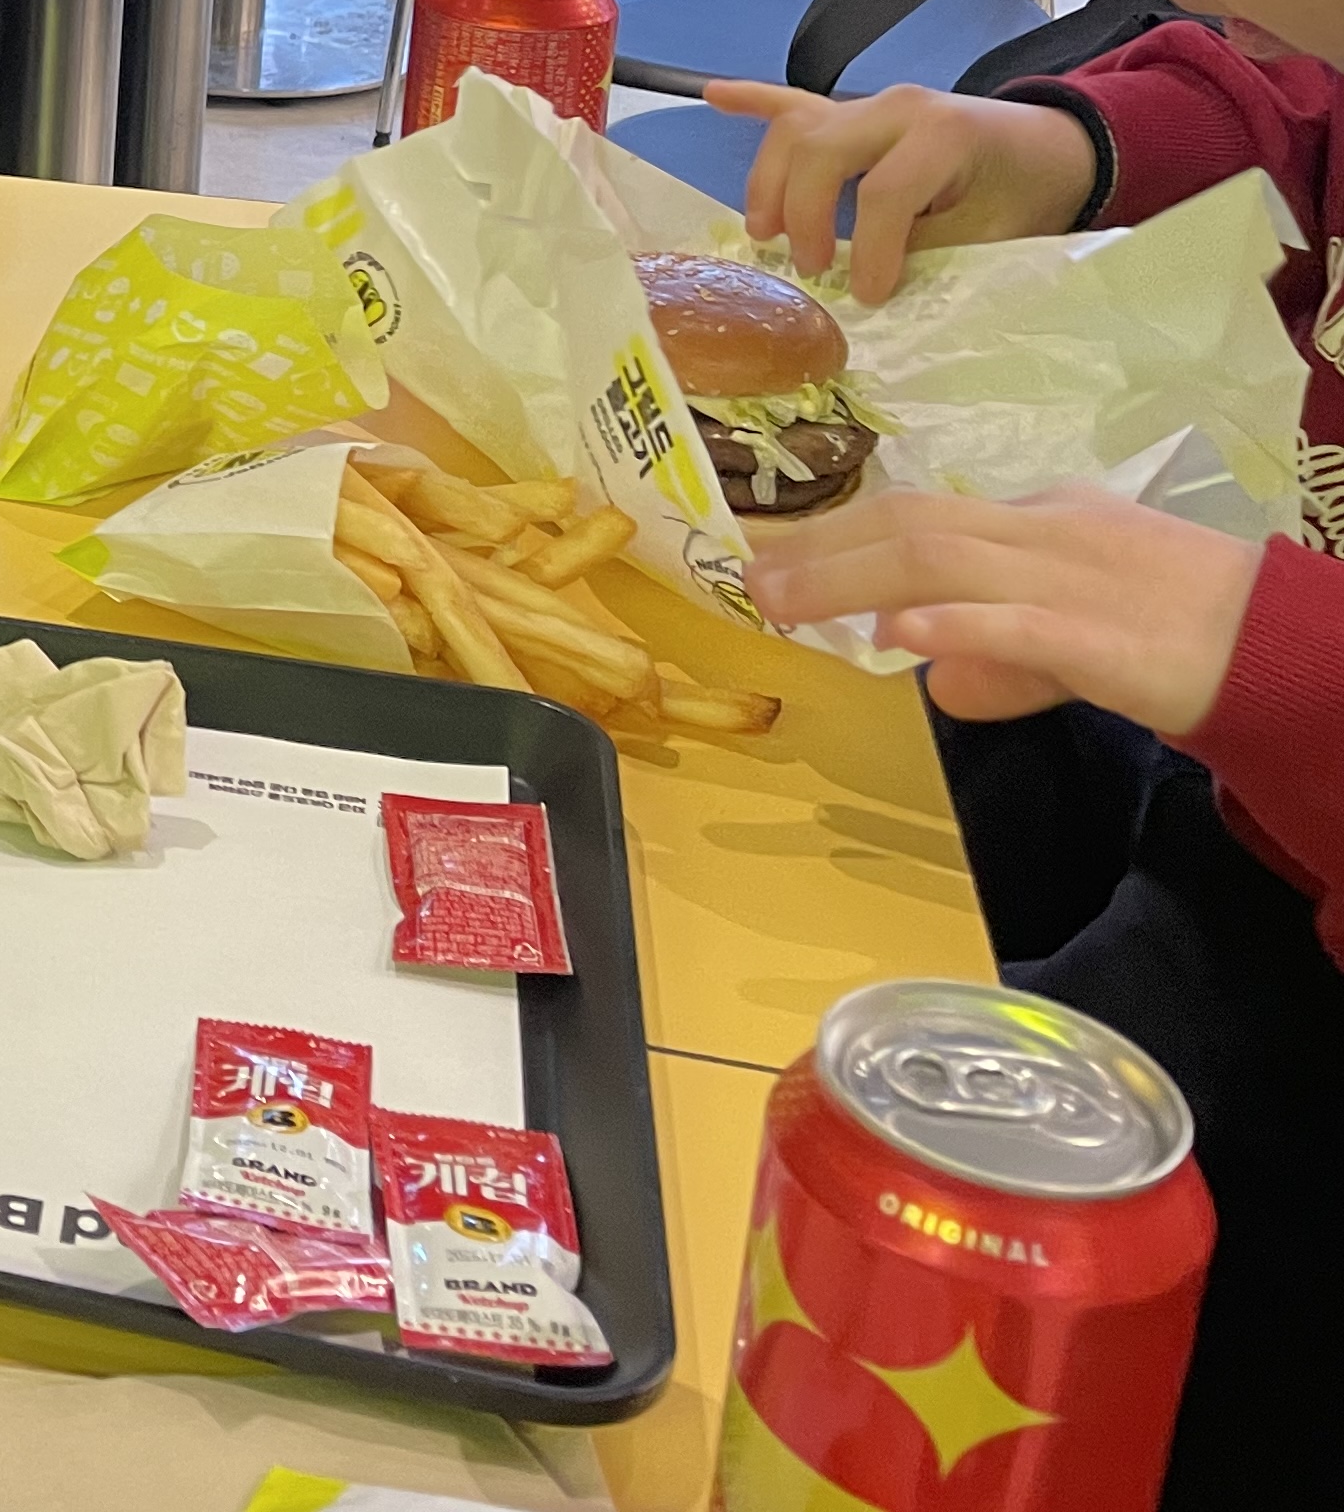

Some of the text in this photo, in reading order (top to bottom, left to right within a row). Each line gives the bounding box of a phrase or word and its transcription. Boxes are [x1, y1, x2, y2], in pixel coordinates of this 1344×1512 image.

[232, 1156, 318, 1188] BRAND
[878, 1191, 1051, 1268] ORIGINAL
[443, 1277, 538, 1298] BRAND
